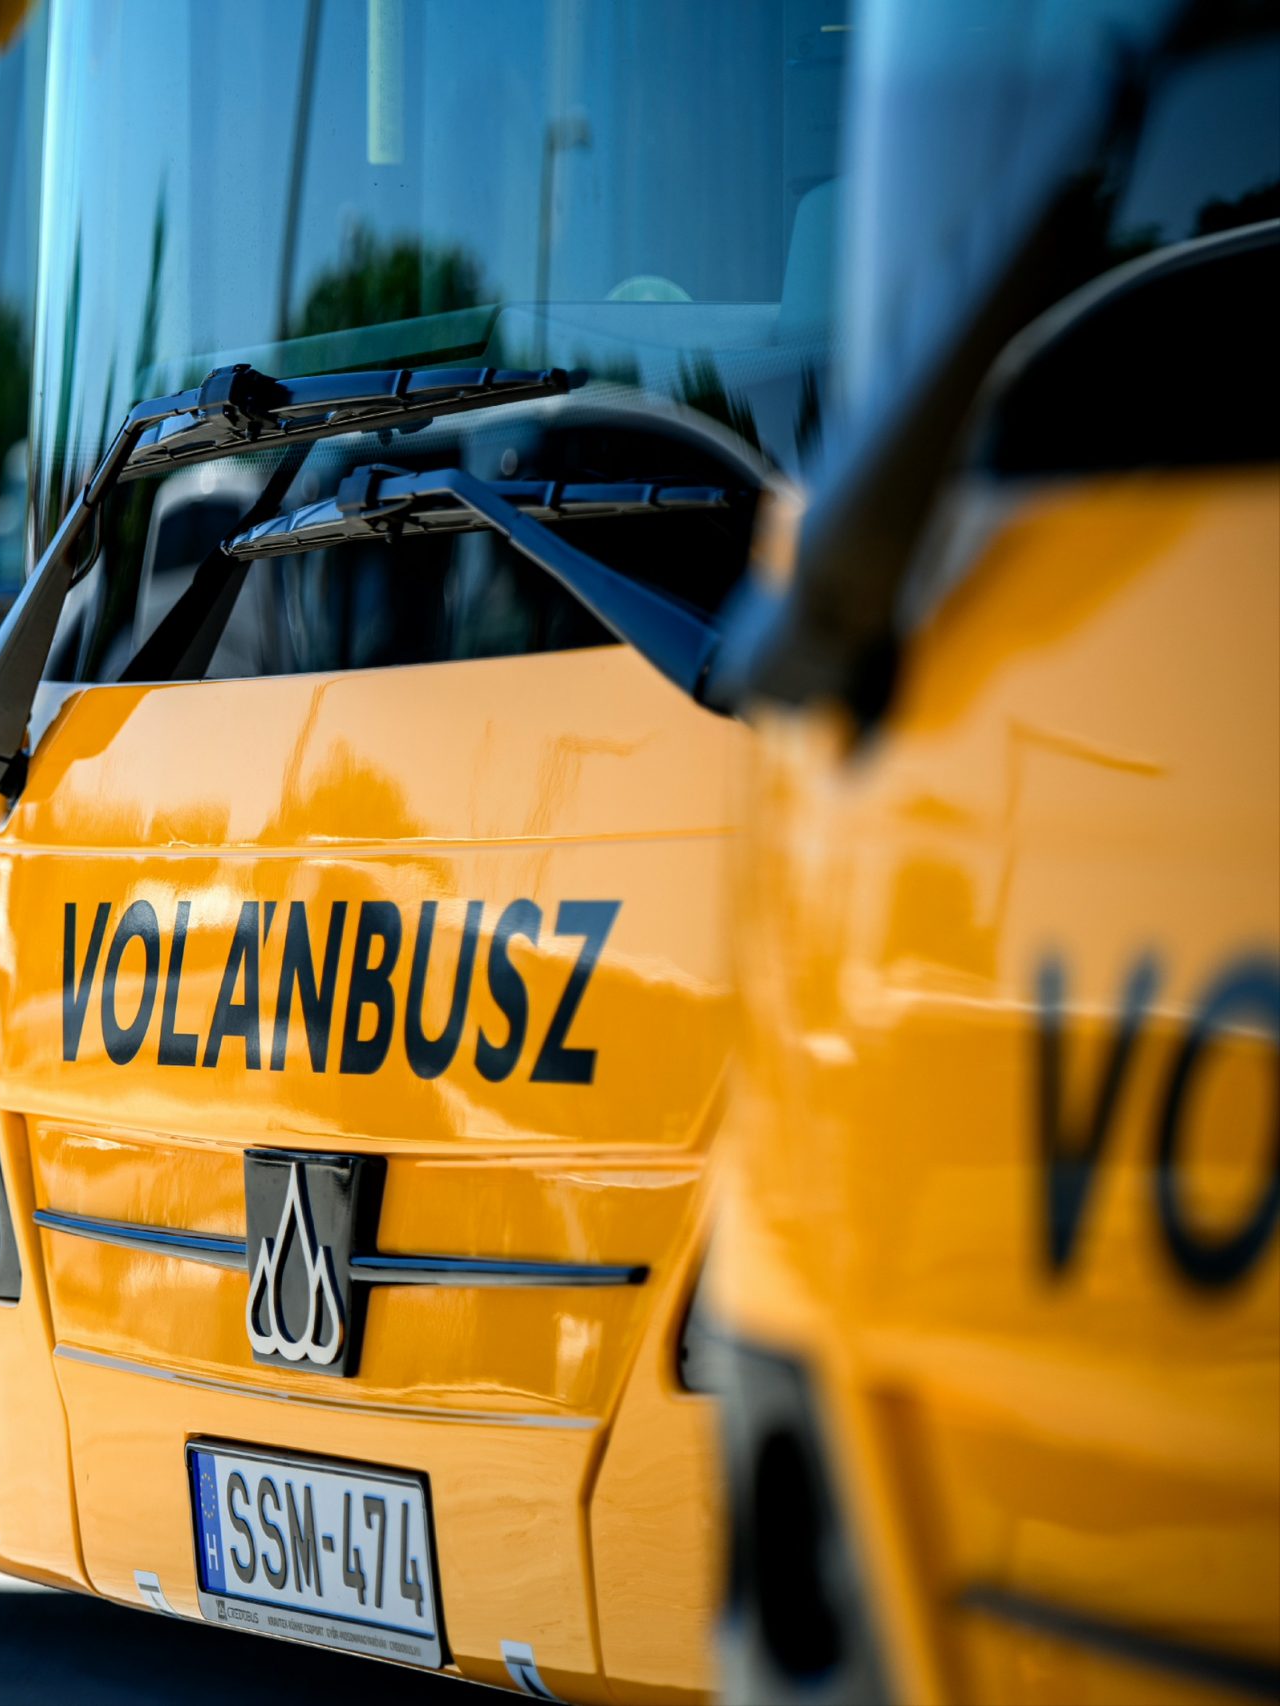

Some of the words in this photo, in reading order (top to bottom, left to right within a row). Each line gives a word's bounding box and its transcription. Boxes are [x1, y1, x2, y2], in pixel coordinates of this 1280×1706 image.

[62, 898, 623, 1085] VOLÁNBUSZ
[206, 1533, 219, 1571] H
[226, 1471, 424, 1617] SSM-474
